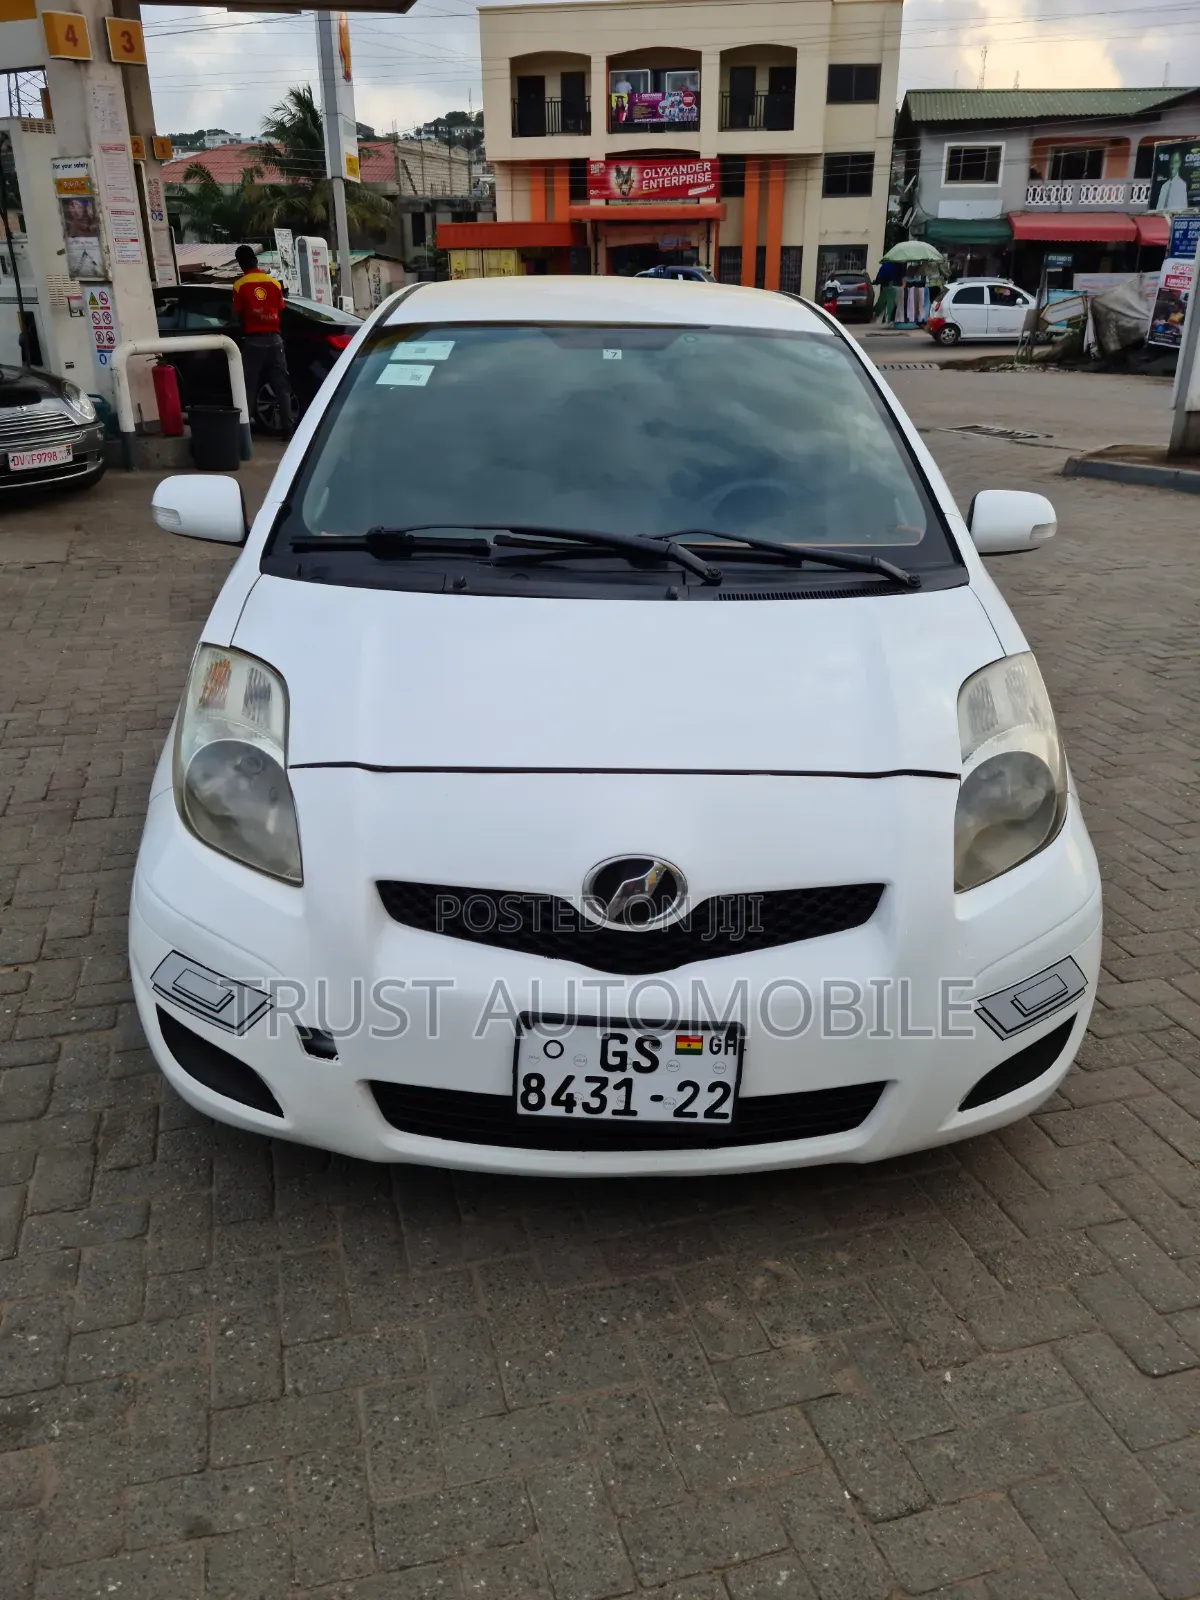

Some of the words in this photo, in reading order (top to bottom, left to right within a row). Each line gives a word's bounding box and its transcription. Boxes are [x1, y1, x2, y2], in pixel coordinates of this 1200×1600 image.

[64, 24, 78, 47] 4
[120, 30, 135, 53] 3
[61, 163, 73, 171] your
[73, 161, 89, 170] safety
[643, 161, 711, 179] OLYXANDER
[642, 172, 711, 190] ENTERPRISE
[600, 1032, 660, 1074] GS
